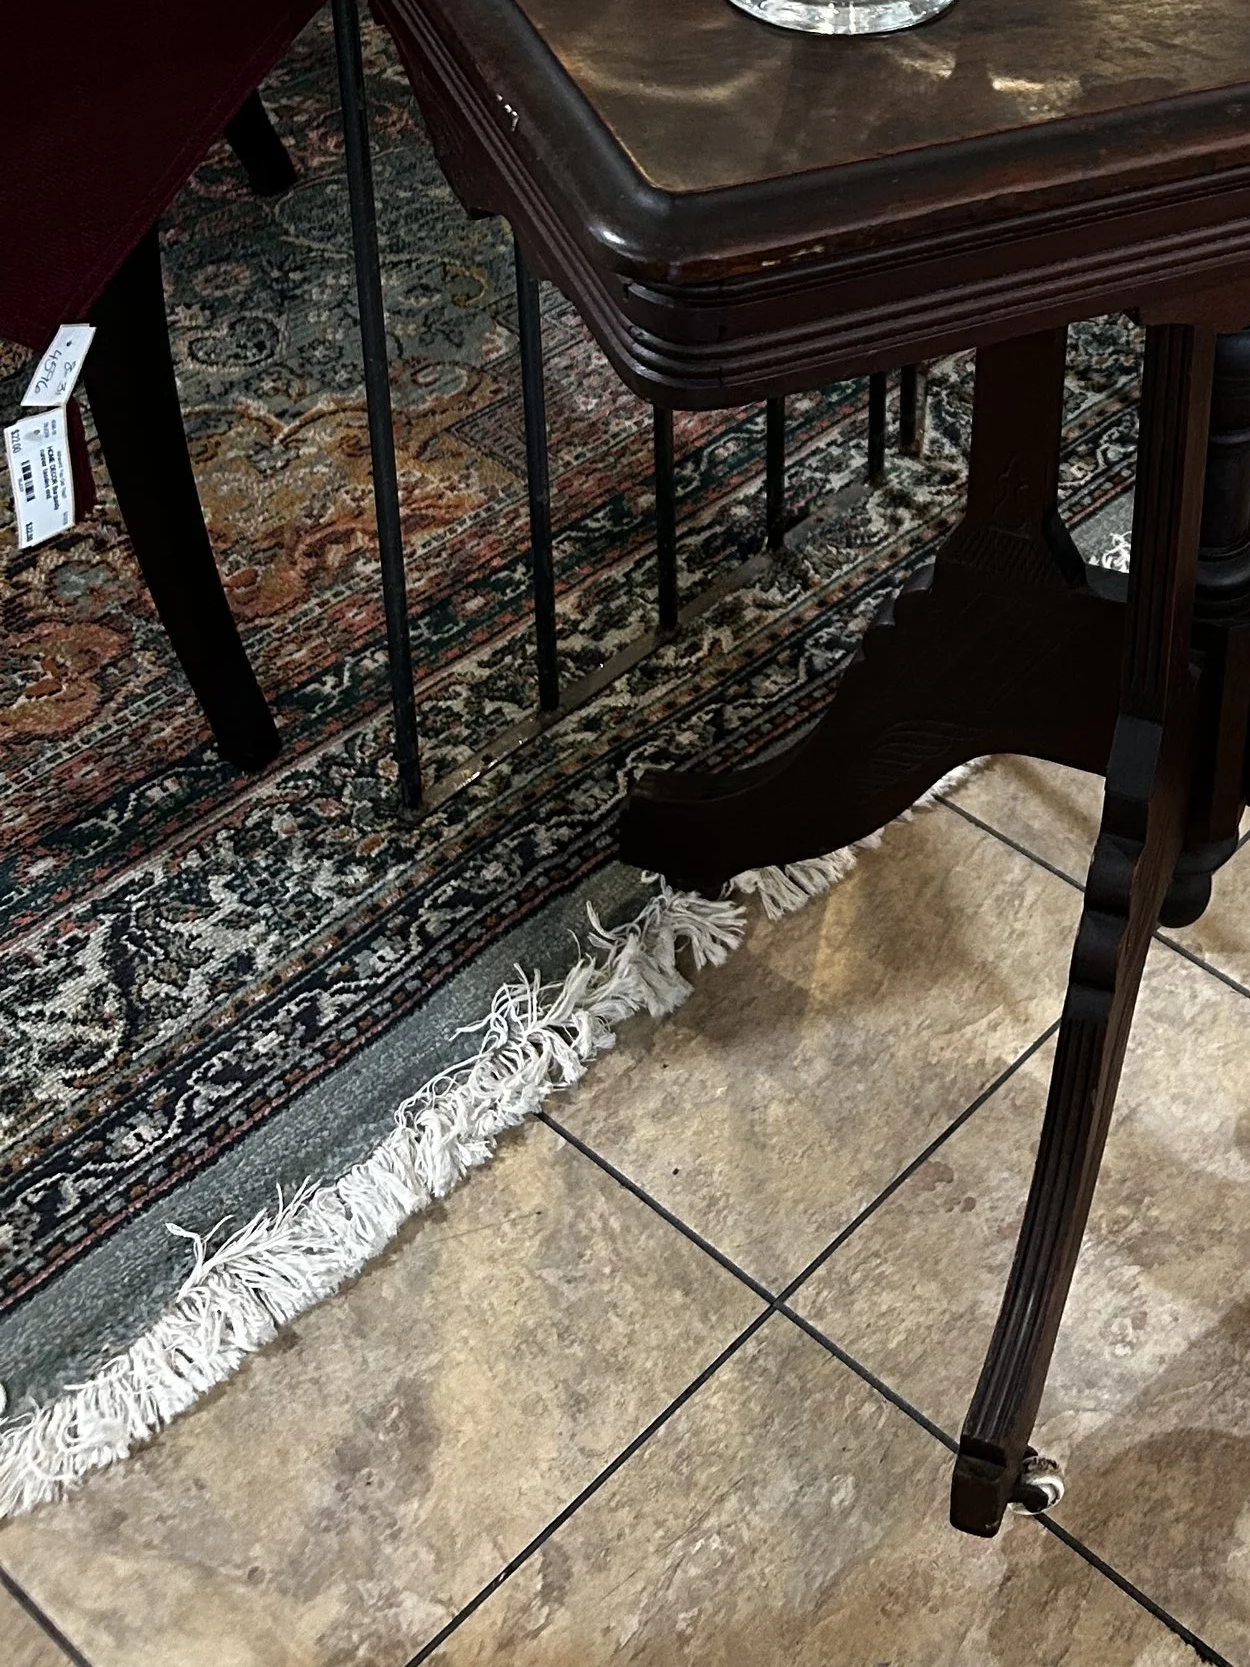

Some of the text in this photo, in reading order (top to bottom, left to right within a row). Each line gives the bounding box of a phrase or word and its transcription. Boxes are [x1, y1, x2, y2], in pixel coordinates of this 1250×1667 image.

[34, 349, 62, 394] 4596
[11, 429, 22, 454] $22.00
[47, 445, 55, 463] HOME
[49, 463, 58, 485] DECOR
